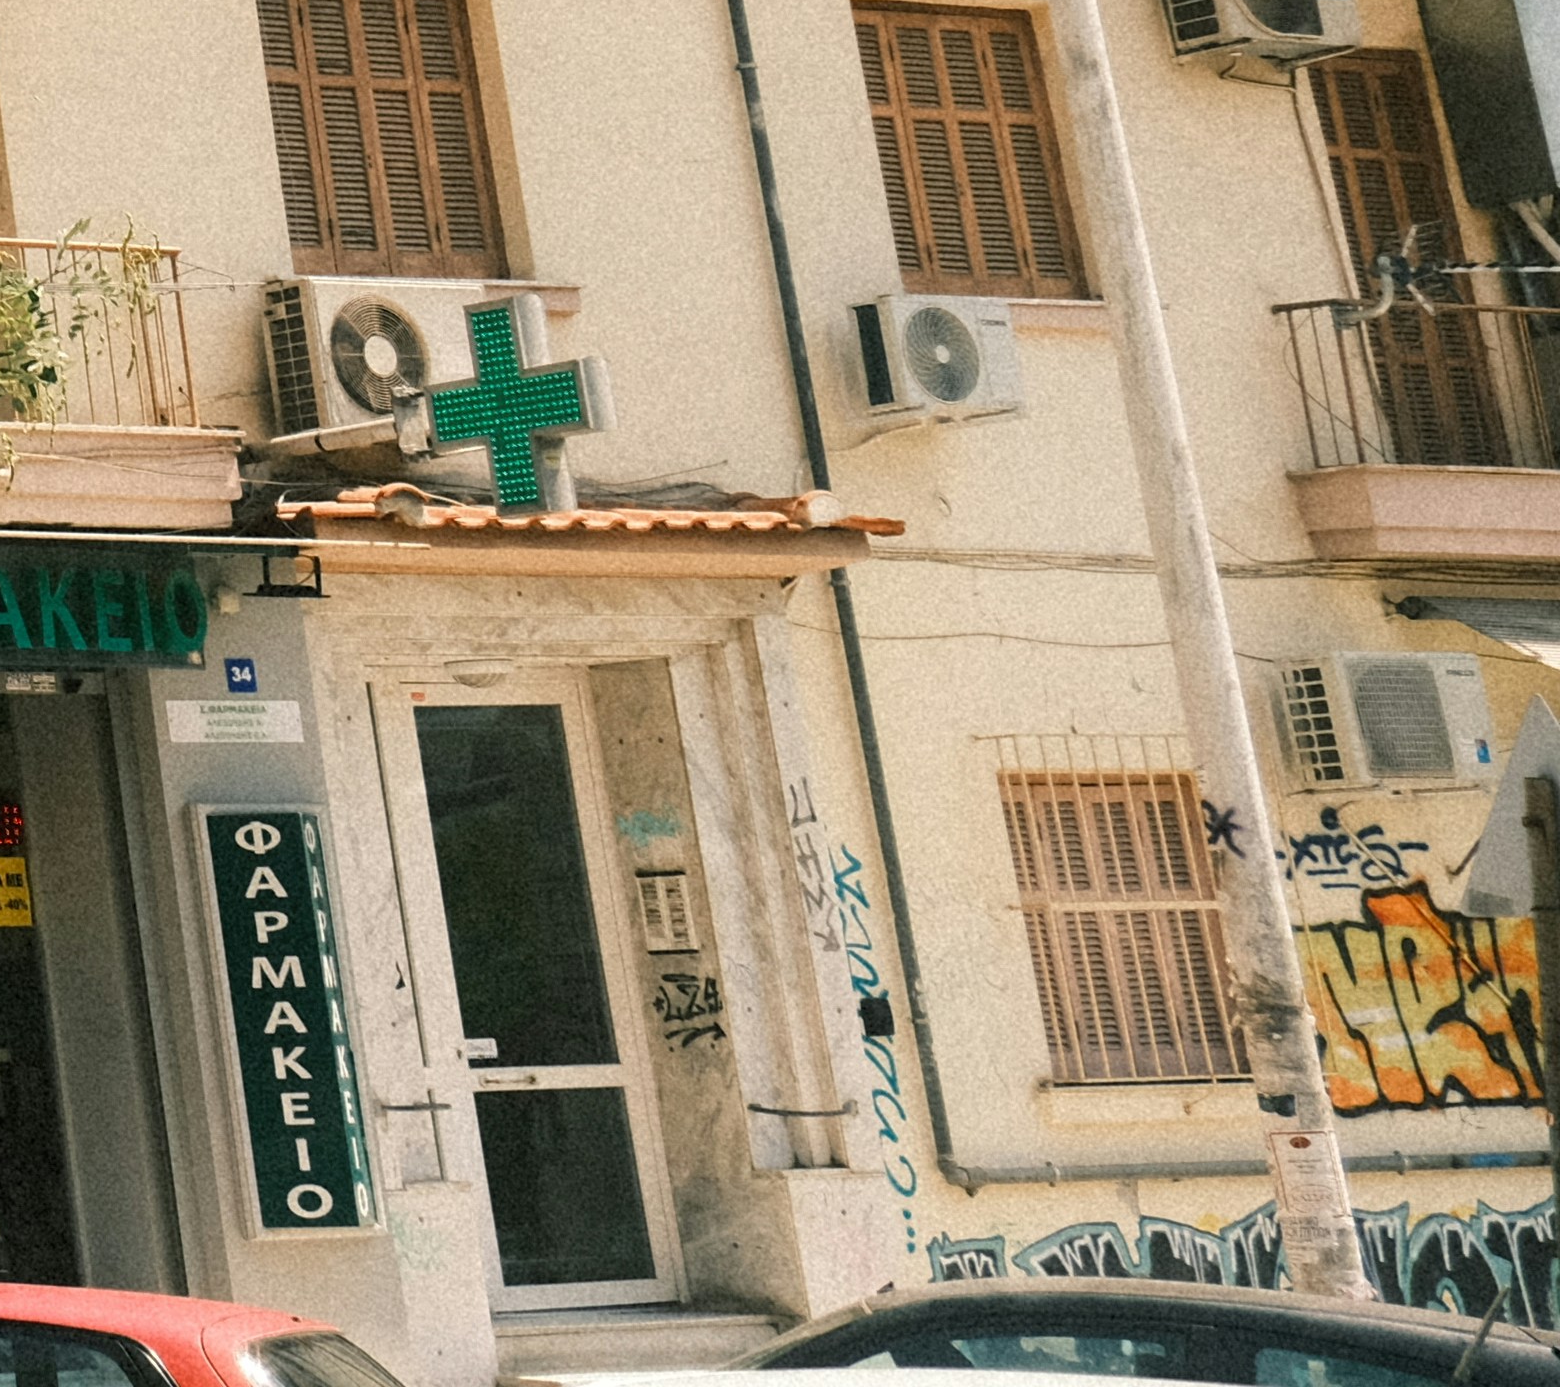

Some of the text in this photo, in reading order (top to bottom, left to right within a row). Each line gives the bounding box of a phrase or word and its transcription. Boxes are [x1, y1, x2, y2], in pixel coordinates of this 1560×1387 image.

[230, 666, 252, 683] 34
[235, 821, 333, 1218] ΦΑΡΜΑΚΕΙΟ
[304, 821, 369, 1217] ΦΑΡΜΑΚΕΙΟ
